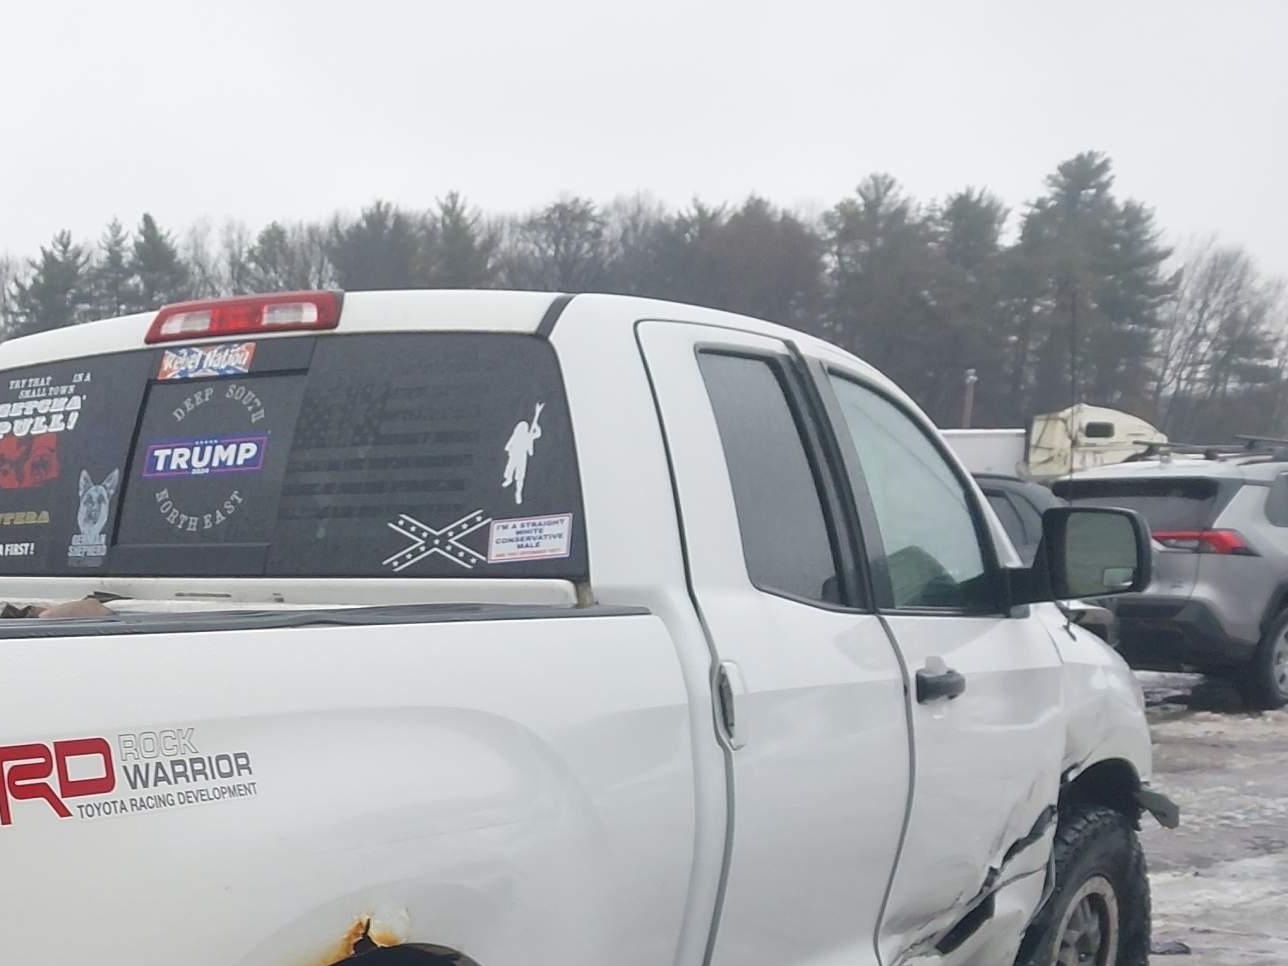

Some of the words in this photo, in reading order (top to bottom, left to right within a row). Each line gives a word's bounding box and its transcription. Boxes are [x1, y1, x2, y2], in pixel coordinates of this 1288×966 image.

[163, 346, 203, 371] Rebel
[204, 343, 249, 370] Nation
[18, 387, 47, 399] SMALL
[48, 384, 76, 396] TOWN
[172, 387, 214, 422] DEEP
[226, 384, 265, 424] SOUTH
[153, 443, 258, 471] TRUMP
[520, 519, 565, 529] STRAIGHT
[496, 533, 563, 544] CONSERVATIVE
[118, 727, 200, 762] ROCK
[123, 752, 253, 790] WARRIOR
[77, 799, 129, 820] TOYOTA
[130, 793, 176, 814] RACING
[178, 782, 258, 808] DEVELOPMENT
